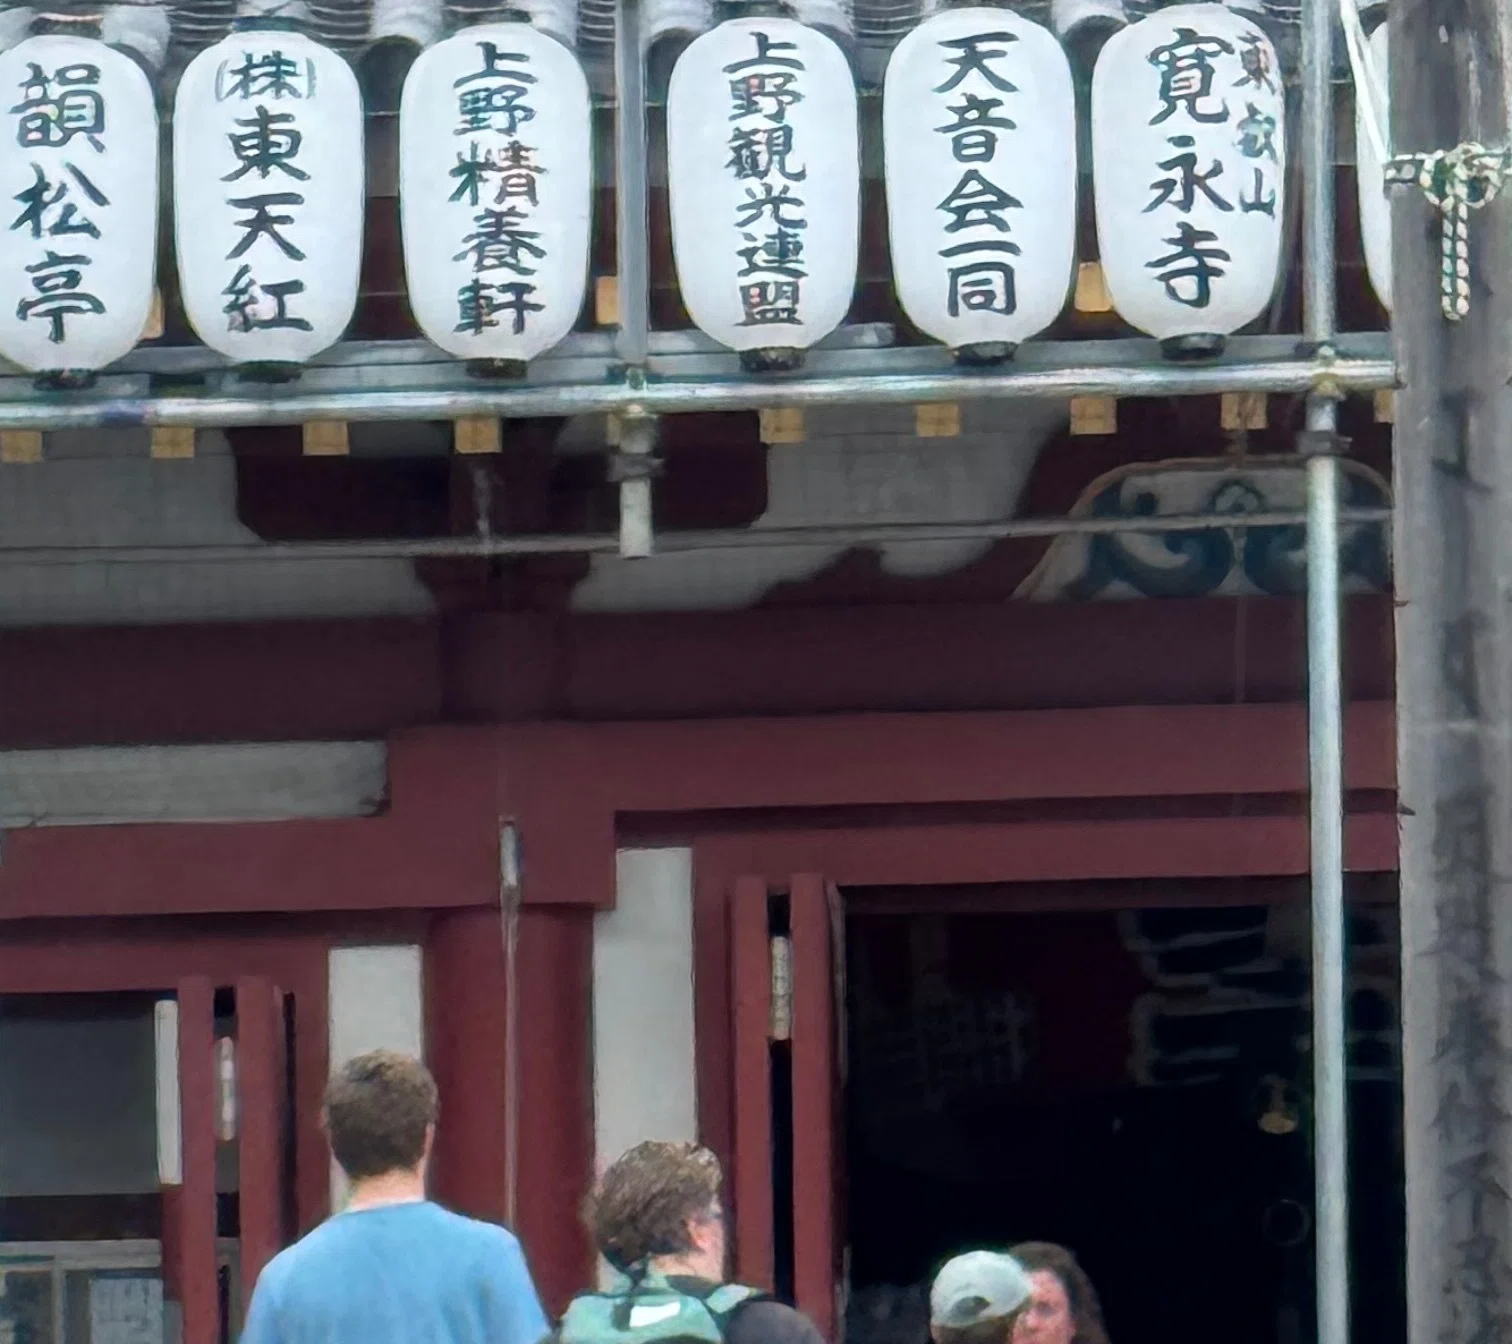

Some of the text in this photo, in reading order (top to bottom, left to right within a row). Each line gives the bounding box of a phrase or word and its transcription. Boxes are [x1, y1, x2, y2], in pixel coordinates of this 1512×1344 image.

[8, 62, 110, 346] 韻松亭
[443, 38, 547, 340] 上野精養軒
[722, 32, 808, 328] 上野観光連盟
[932, 31, 1024, 318] 天音会一同
[1142, 28, 1235, 310] 寛永寺
